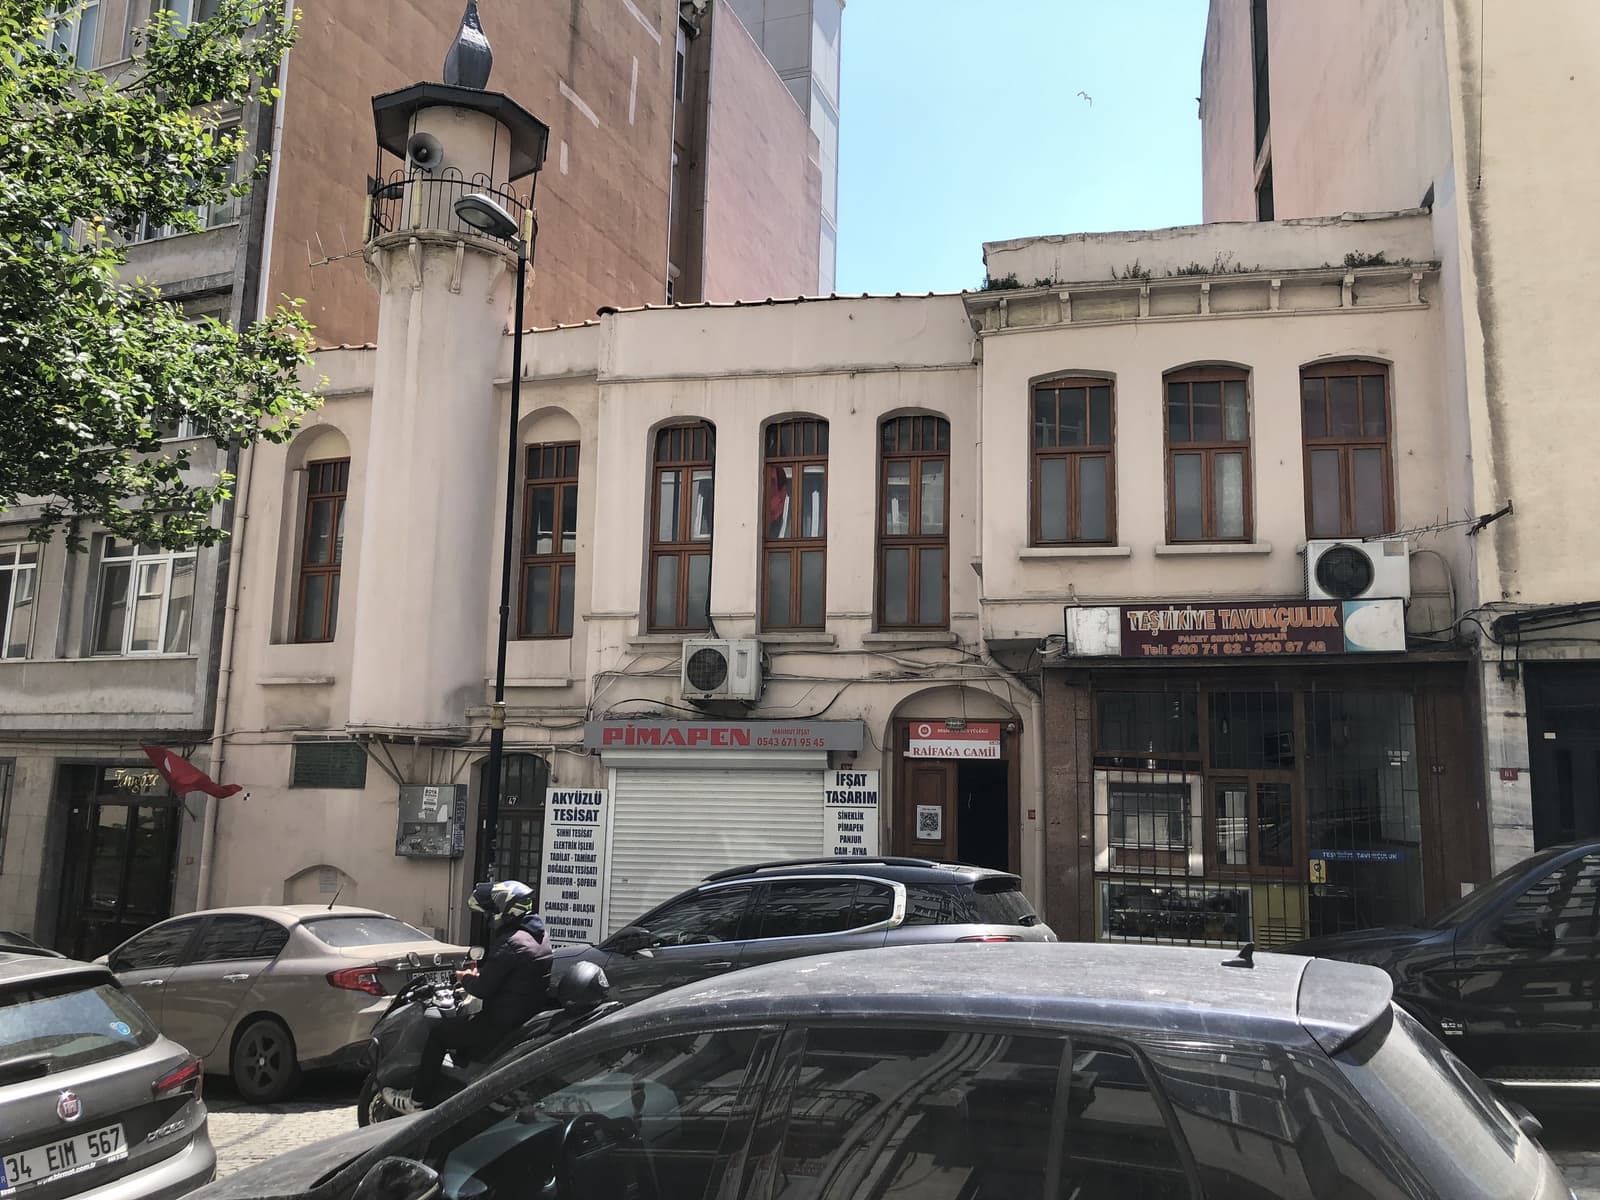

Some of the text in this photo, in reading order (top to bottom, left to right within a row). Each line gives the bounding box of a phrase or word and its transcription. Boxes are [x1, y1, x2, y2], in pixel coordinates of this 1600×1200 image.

[1218, 606, 1339, 632] TAVUKÇULUK
[1178, 635, 1208, 643] PAKET
[1250, 633, 1287, 641] YAPILIR
[1202, 643, 1218, 655] 71
[602, 724, 750, 746] PİMAPEN
[757, 737, 825, 747] 0543 671 95 45
[913, 745, 996, 757] RAİFAĞA CAMİİ
[836, 771, 867, 789] İFŞAT
[552, 790, 602, 805] AKYÜZLÜ
[825, 791, 877, 804] TASARIM
[553, 807, 600, 822] TESİSAT
[838, 810, 864, 820] SİNEKLİK
[572, 828, 593, 838] TESİSAT
[838, 822, 864, 832] PİMAPEN
[553, 840, 595, 851] ELEKTRİK İŞLERİ
[840, 835, 862, 844] PANJUR
[550, 851, 570, 862] TADİLAT
[574, 853, 597, 863] TAMİRAT
[834, 847, 848, 856] CAM
[852, 848, 867, 856] AYNA
[547, 863, 598, 875] DOĞALGAZ TESİSATI
[546, 875, 573, 886] HİDROFOR
[577, 878, 597, 888] ŞOFBEN
[562, 889, 579, 900] KOMBİ
[544, 901, 569, 913] ÇAMAŞIR
[572, 903, 595, 915] BULAŞIK
[572, 917, 594, 928] MONTAJ
[549, 927, 587, 940] İŞLERİ YAPILIR
[6, 1128, 121, 1183] 34 EIM 567
